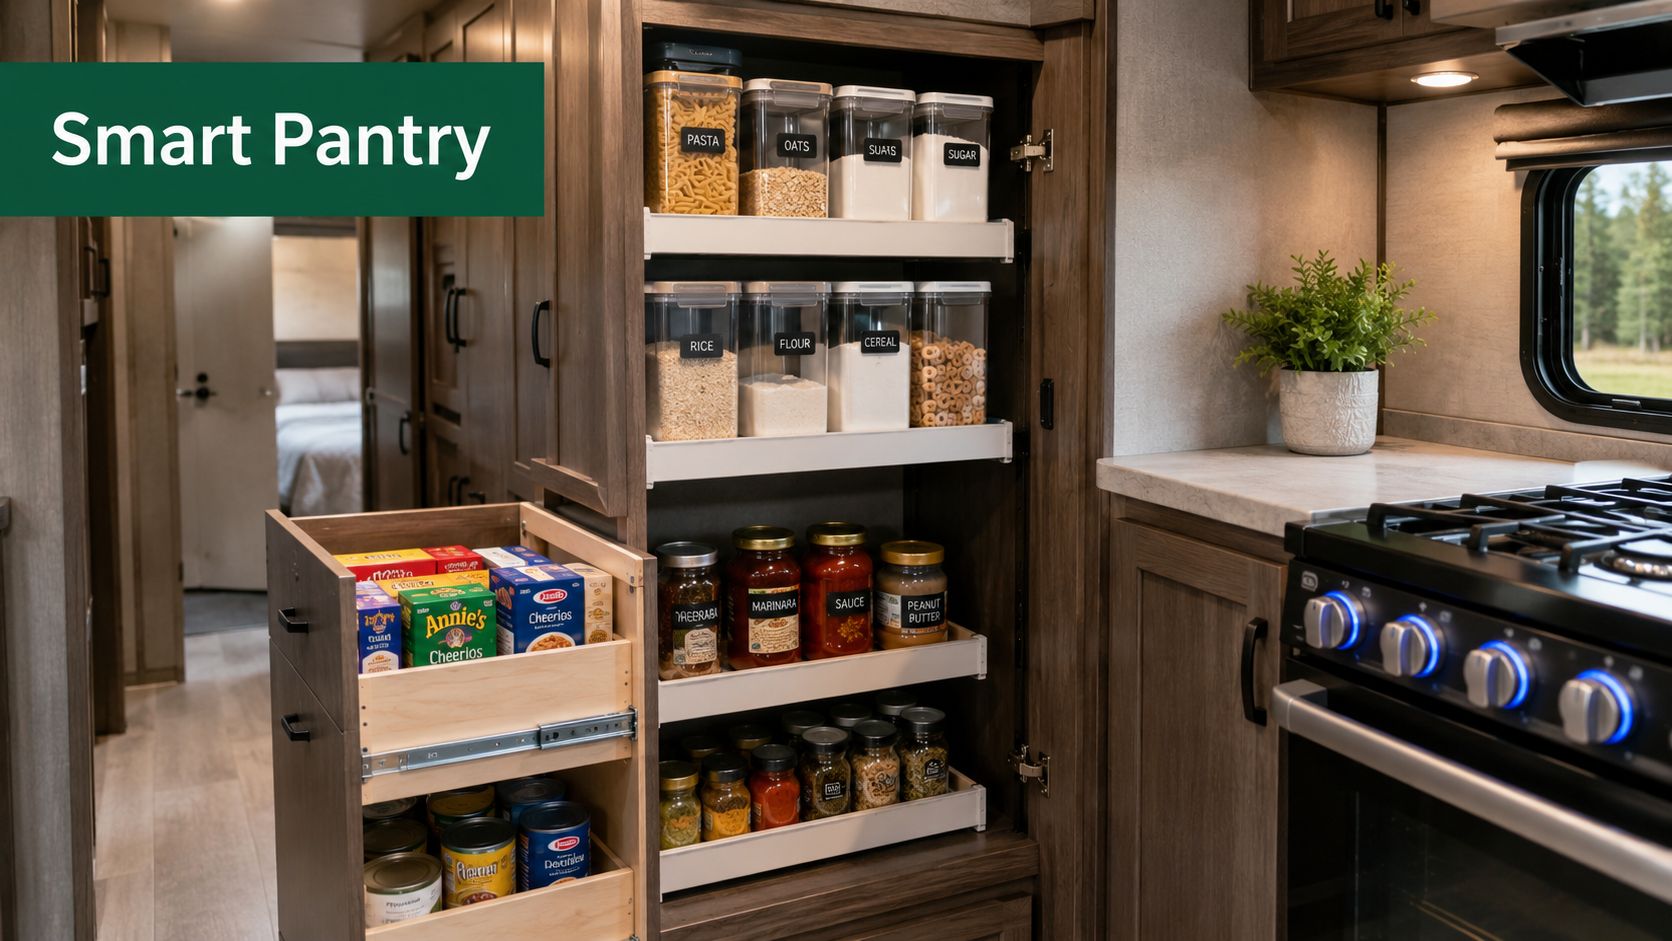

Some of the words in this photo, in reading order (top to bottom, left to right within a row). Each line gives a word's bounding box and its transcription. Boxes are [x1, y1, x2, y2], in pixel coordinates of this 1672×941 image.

[687, 133, 720, 147] PASTA
[784, 139, 810, 152] OATS
[948, 148, 976, 161] SUGAR
[690, 340, 714, 352] RICE
[779, 338, 811, 350] FLOUR
[864, 336, 897, 348] CEREAL
[752, 598, 797, 612] MARINARA
[835, 596, 865, 610] SAUCE
[907, 598, 941, 611] PEANUT
[425, 606, 487, 639] Annie's
[528, 609, 573, 625] Cheerios
[909, 611, 941, 623] BUTTER
